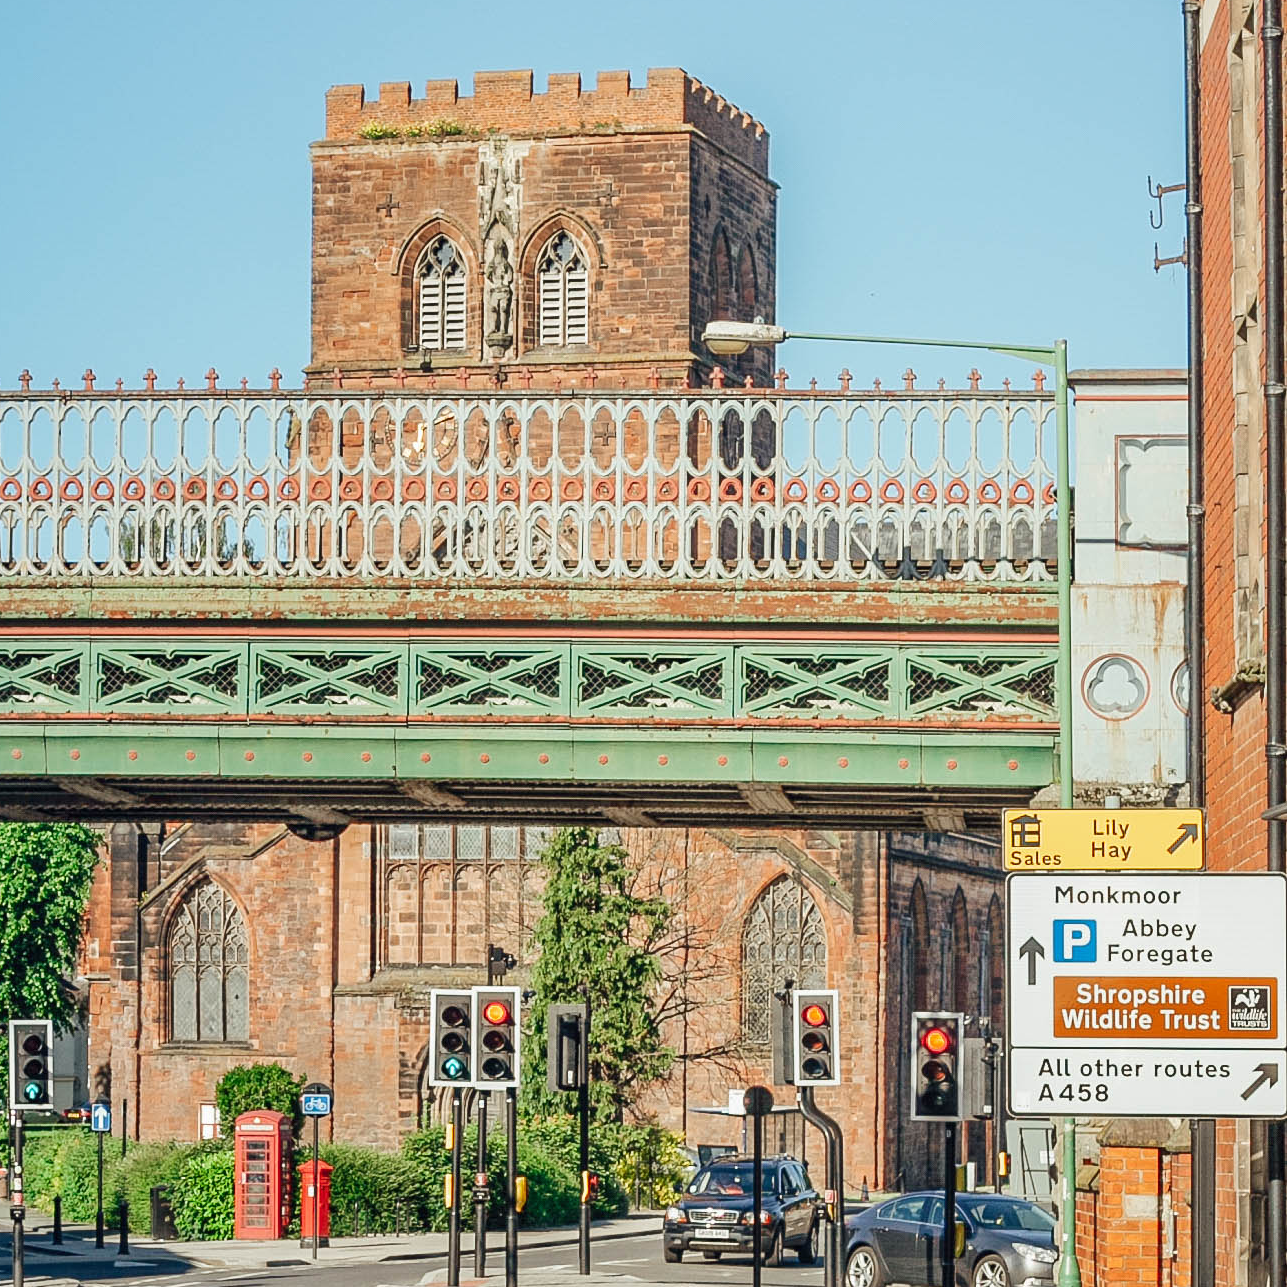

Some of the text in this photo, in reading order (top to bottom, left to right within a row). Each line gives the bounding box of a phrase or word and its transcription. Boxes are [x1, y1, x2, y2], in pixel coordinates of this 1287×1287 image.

[1093, 818, 1130, 839] Lily
[1010, 850, 1062, 866] Sales
[1091, 841, 1132, 862] Hay
[1055, 885, 1182, 904] Monkmoor
[1122, 919, 1197, 941] Abbey
[1063, 923, 1091, 960] P
[1107, 944, 1213, 966] Foregate
[1077, 983, 1205, 1008] Shropshire
[1062, 1008, 1221, 1030] Wildlife Trust
[1039, 1059, 1231, 1078] All other routes
[1039, 1084, 1109, 1102] A458
